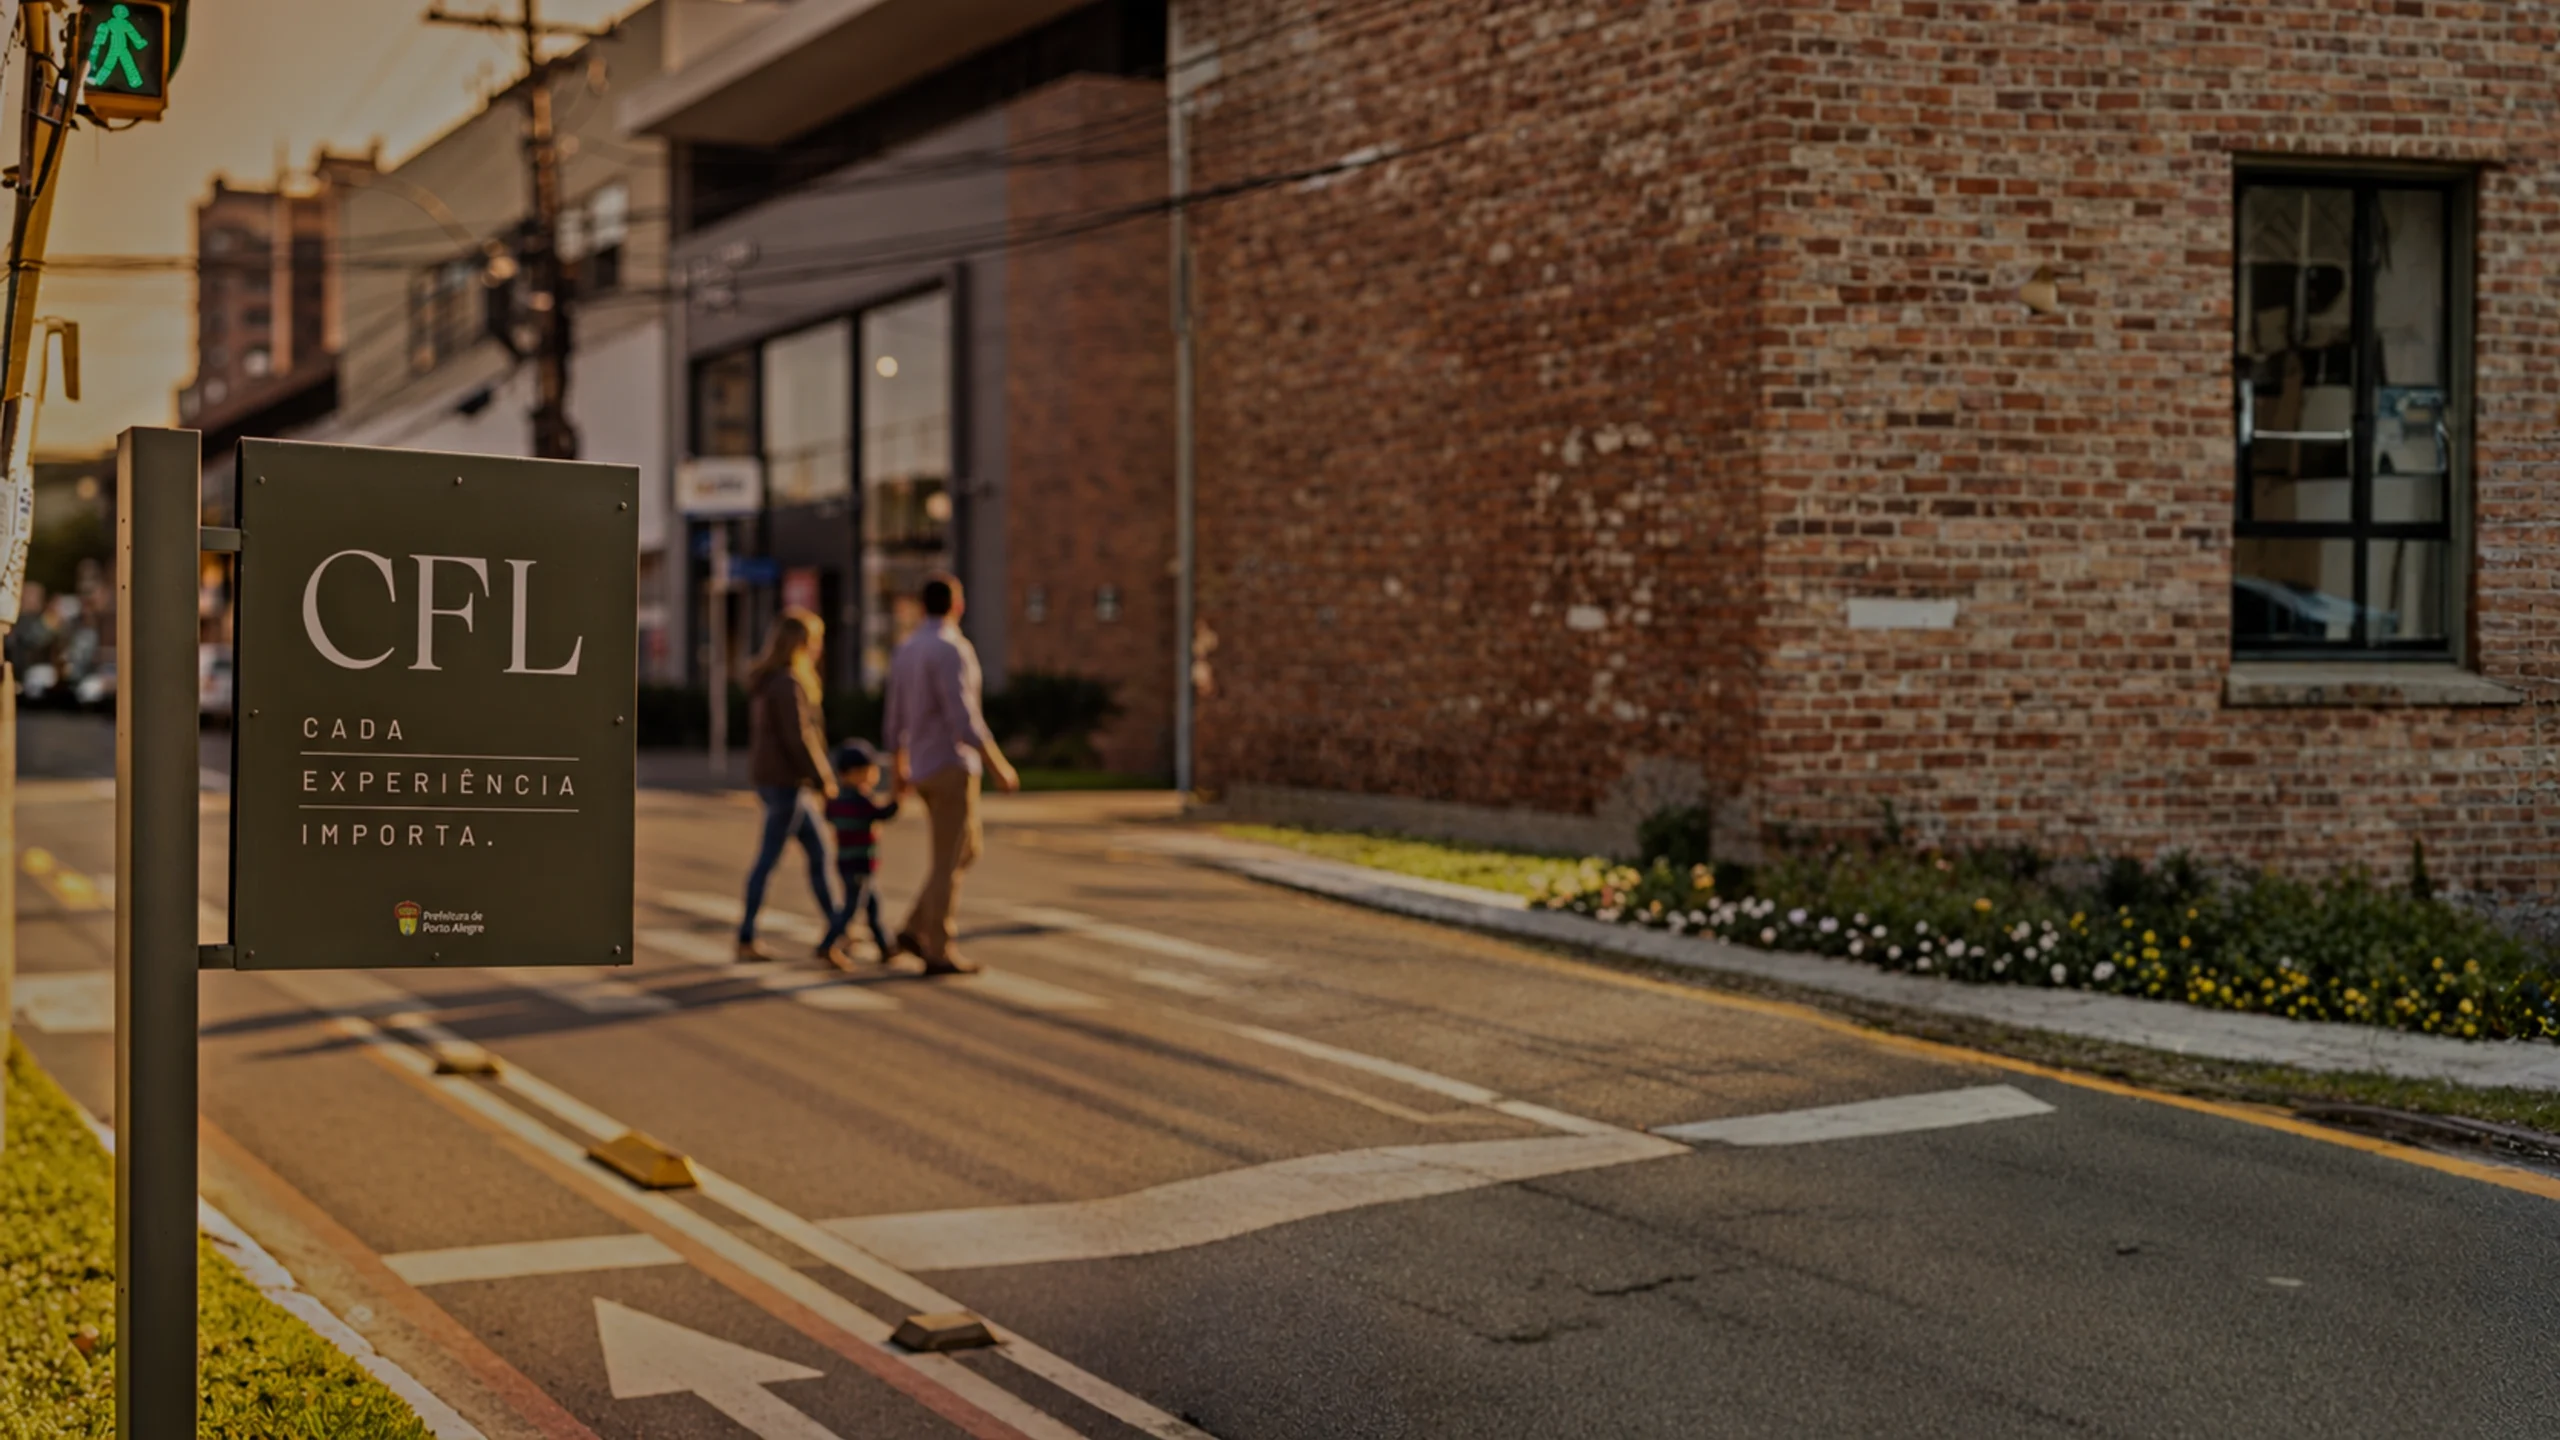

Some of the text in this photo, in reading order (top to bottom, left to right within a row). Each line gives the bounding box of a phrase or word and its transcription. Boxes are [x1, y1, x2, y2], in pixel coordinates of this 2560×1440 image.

[302, 549, 583, 675] CFL
[303, 717, 403, 741] CADA
[303, 768, 574, 796] EXPERIÊNCIA
[302, 823, 493, 847] IMPORTA.
[423, 910, 484, 921] Prefeitura de
[422, 922, 485, 936] Porto Alegre
